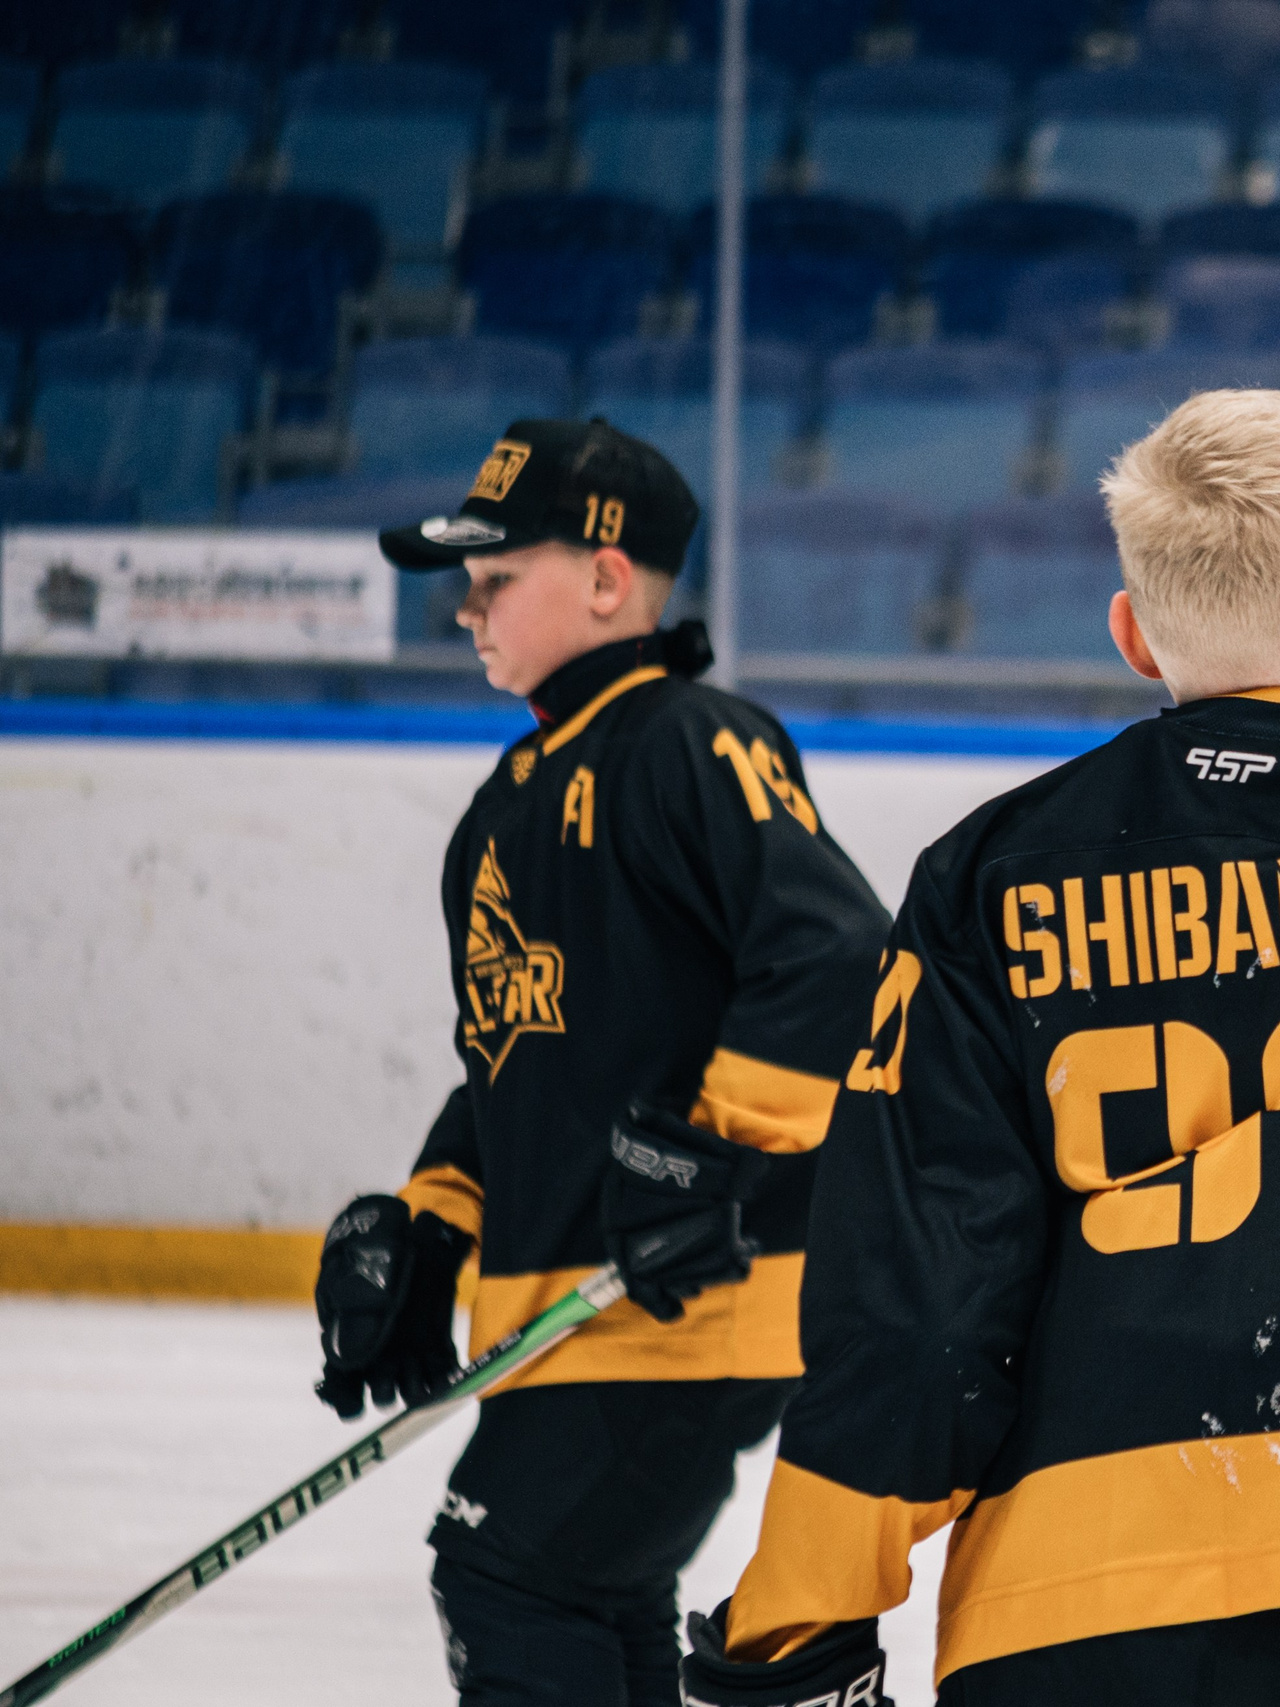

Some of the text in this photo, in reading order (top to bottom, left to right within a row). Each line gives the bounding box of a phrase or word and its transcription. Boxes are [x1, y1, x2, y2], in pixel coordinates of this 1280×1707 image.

[583, 492, 625, 545] 19
[560, 765, 595, 849] A
[712, 728, 819, 837] 19
